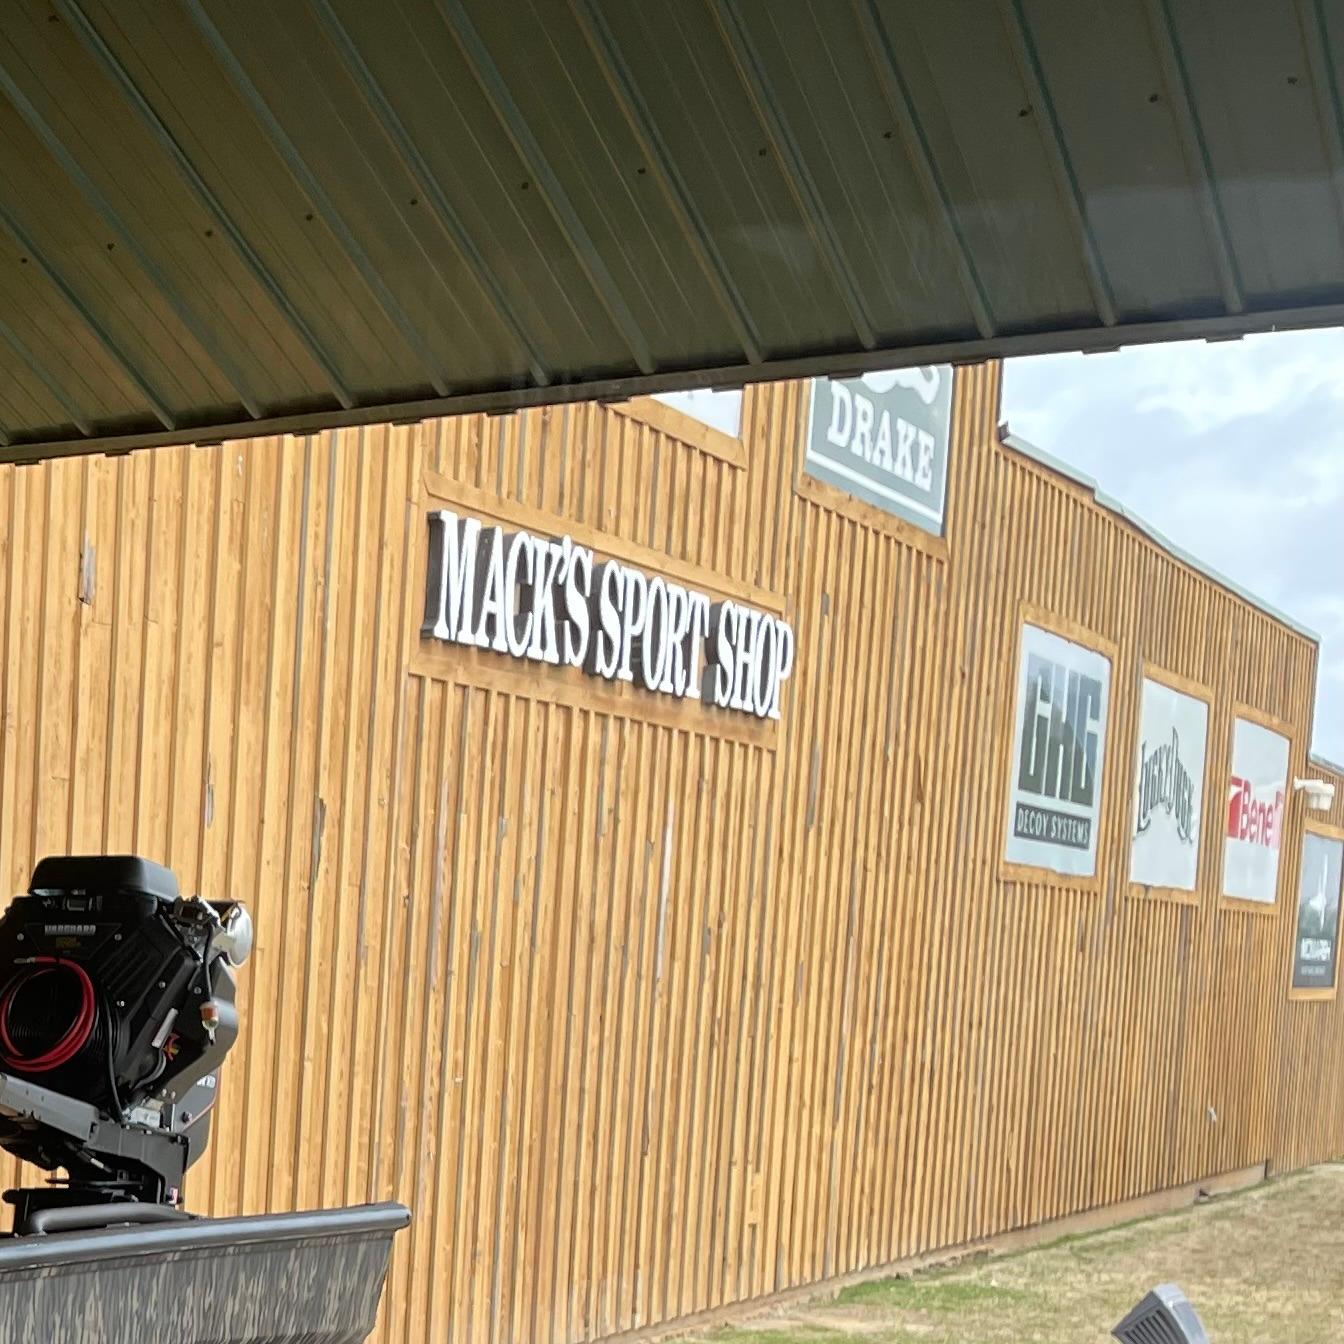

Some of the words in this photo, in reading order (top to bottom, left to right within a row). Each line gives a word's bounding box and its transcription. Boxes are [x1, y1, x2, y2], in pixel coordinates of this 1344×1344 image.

[827, 380, 935, 492] DRAKE
[433, 509, 593, 667] MACK'S
[596, 560, 710, 699] SPORT
[715, 600, 794, 720] SHOP
[1018, 807, 1048, 836] DECOY
[1050, 814, 1090, 845] SYSTEMS
